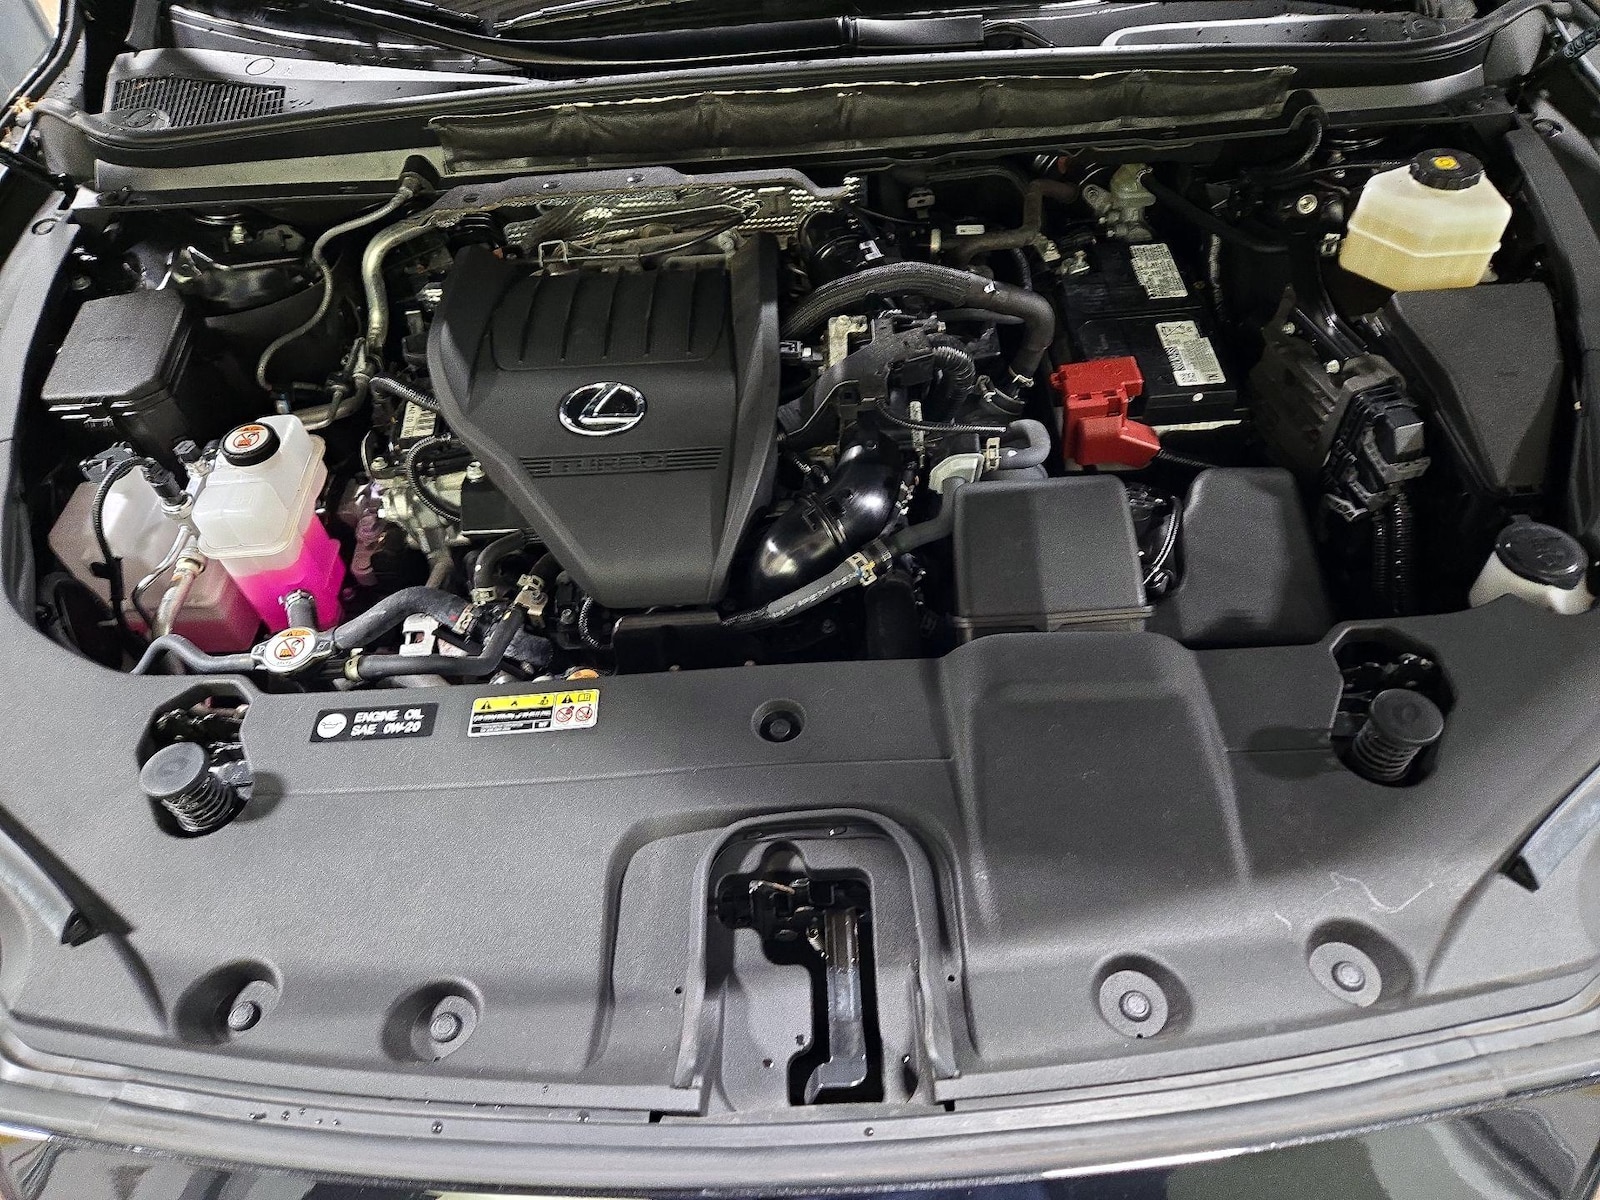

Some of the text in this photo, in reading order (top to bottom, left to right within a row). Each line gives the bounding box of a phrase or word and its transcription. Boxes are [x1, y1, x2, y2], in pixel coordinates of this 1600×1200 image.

[353, 708, 425, 724] ENGINE OIL
[350, 720, 422, 737] SAE 0W-20
